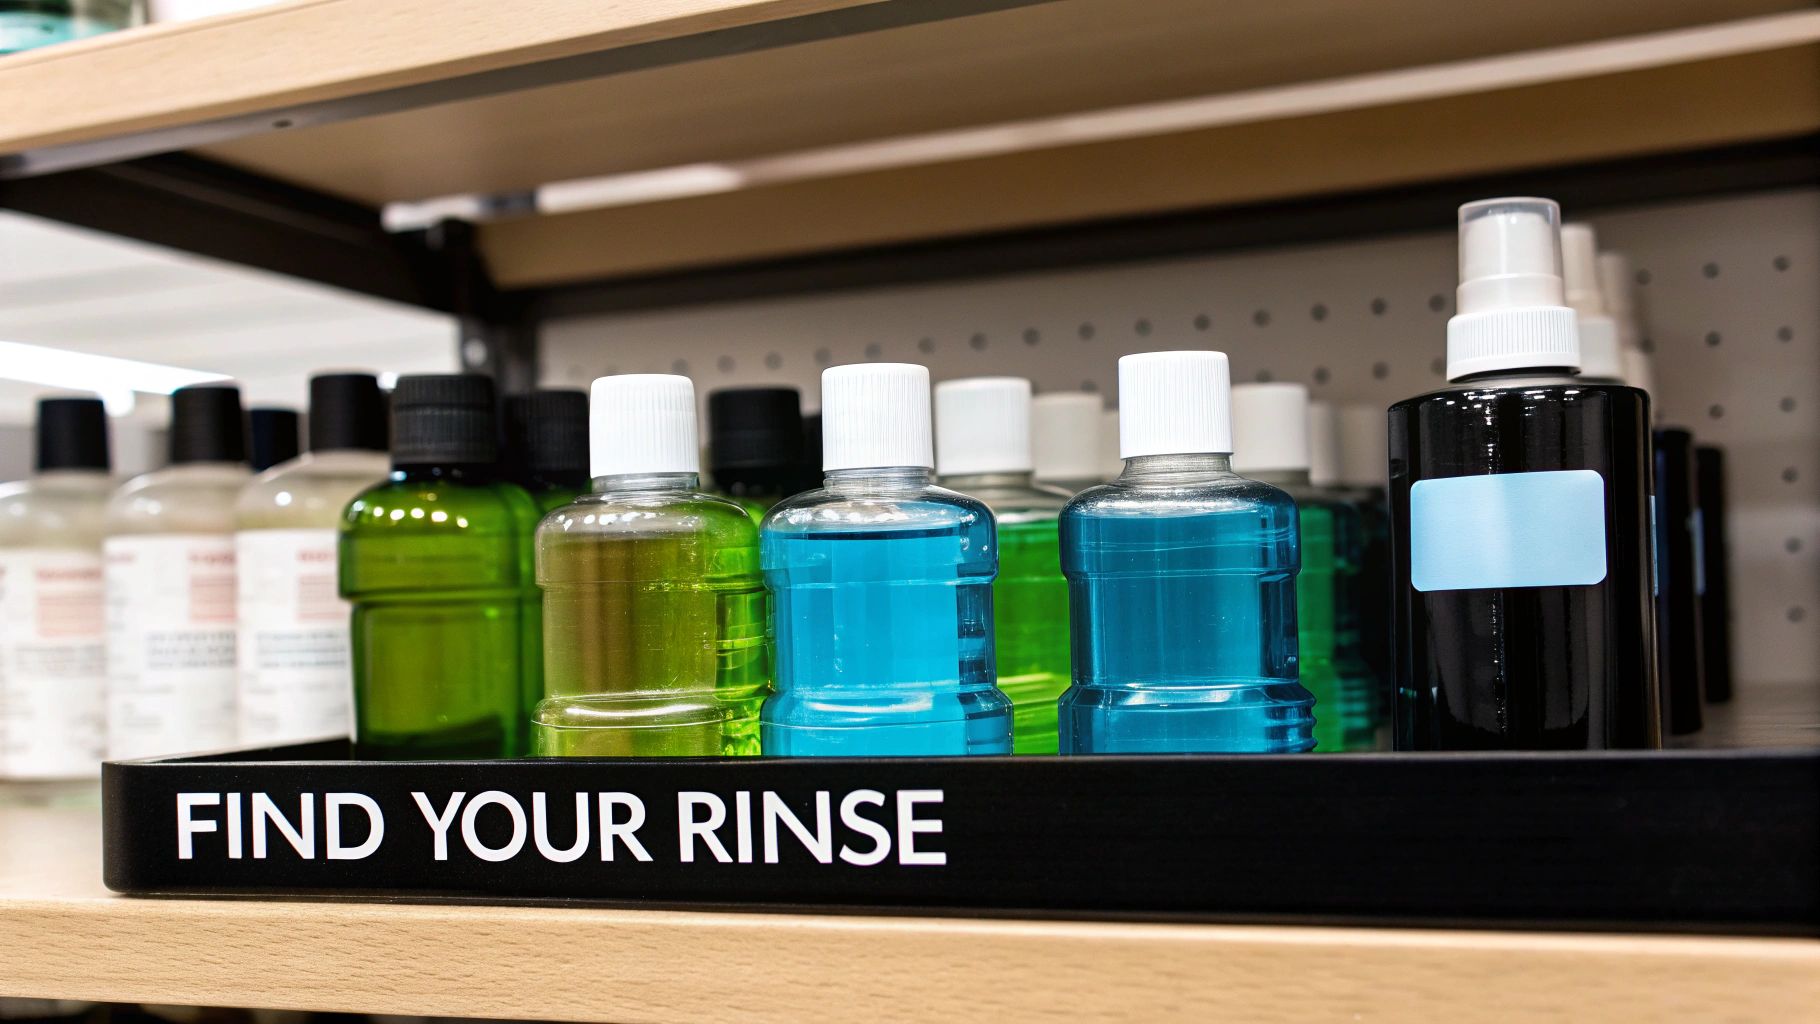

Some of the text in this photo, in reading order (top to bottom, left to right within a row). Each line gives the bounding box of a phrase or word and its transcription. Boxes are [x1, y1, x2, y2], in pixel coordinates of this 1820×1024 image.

[176, 789, 947, 865] FIND YOUR RINSE
